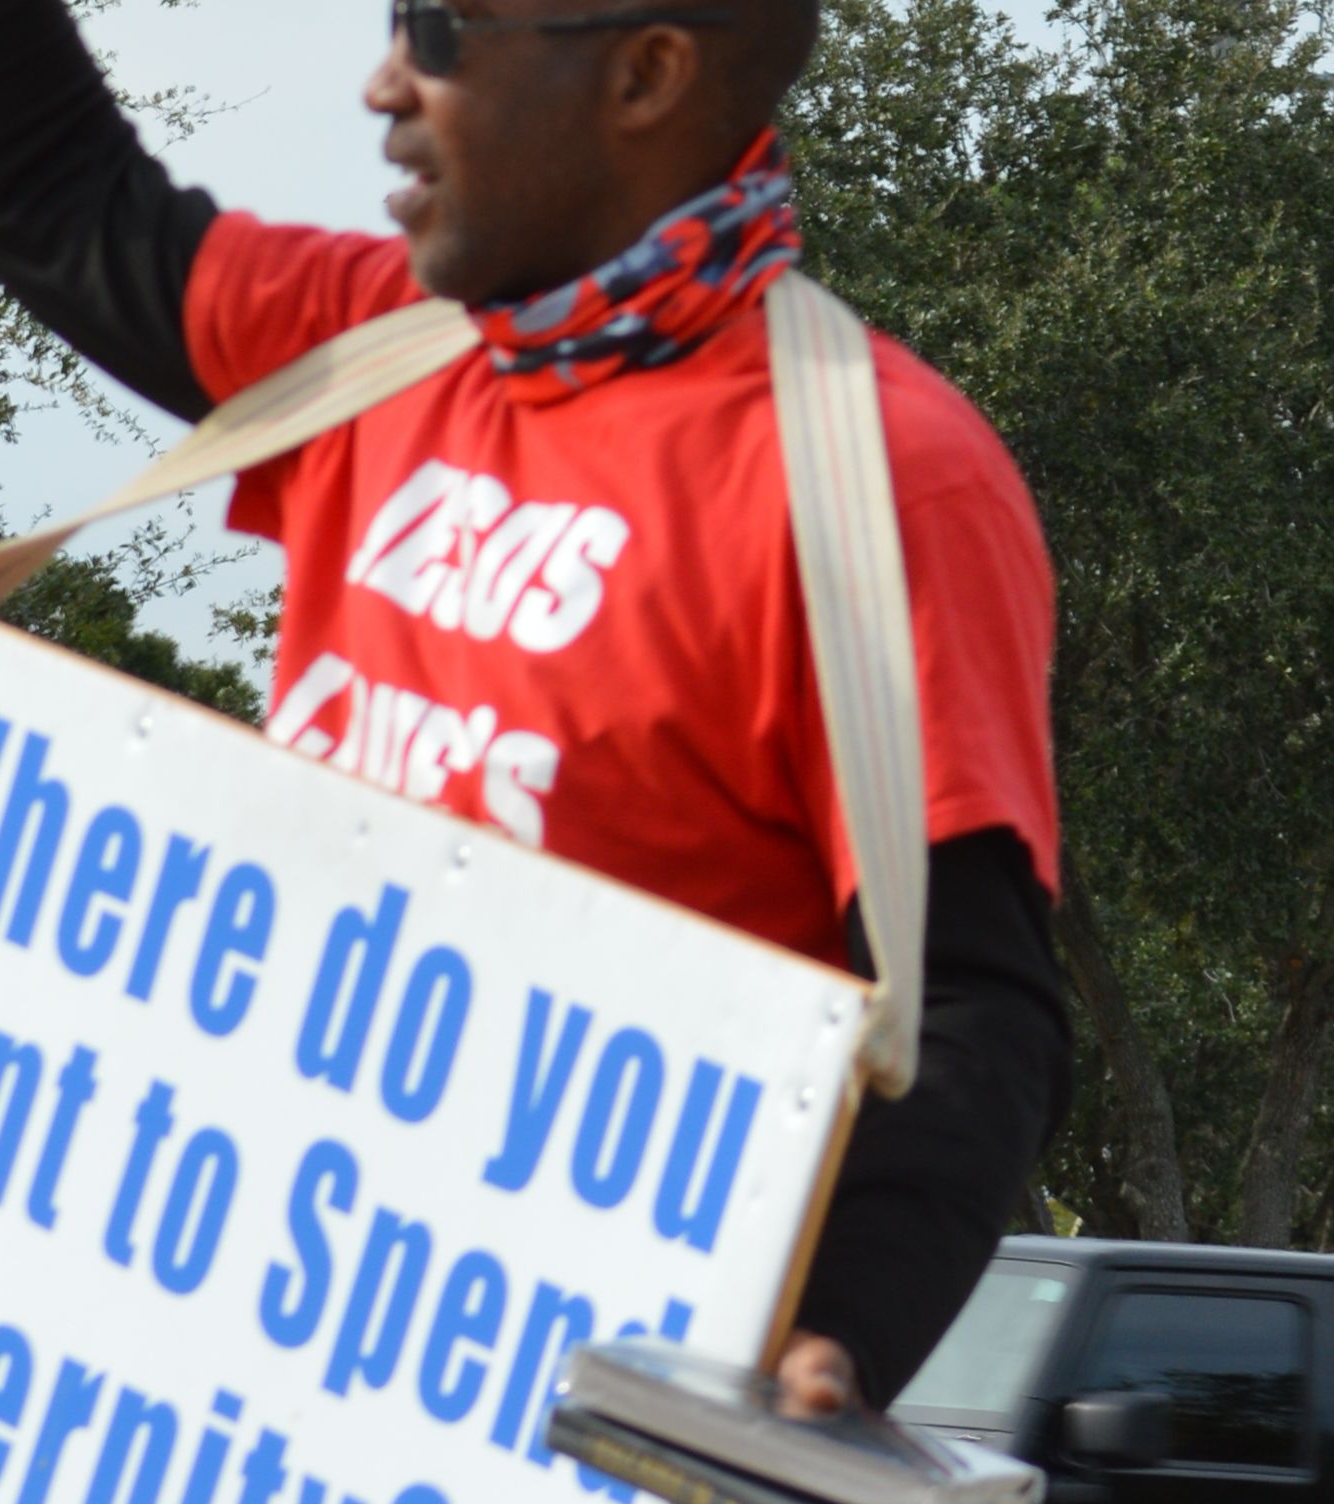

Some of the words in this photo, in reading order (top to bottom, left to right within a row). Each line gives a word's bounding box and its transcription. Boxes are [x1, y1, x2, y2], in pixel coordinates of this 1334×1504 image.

[102, 1079, 240, 1296] to
[294, 881, 473, 1125] do
[481, 987, 764, 1255] you
